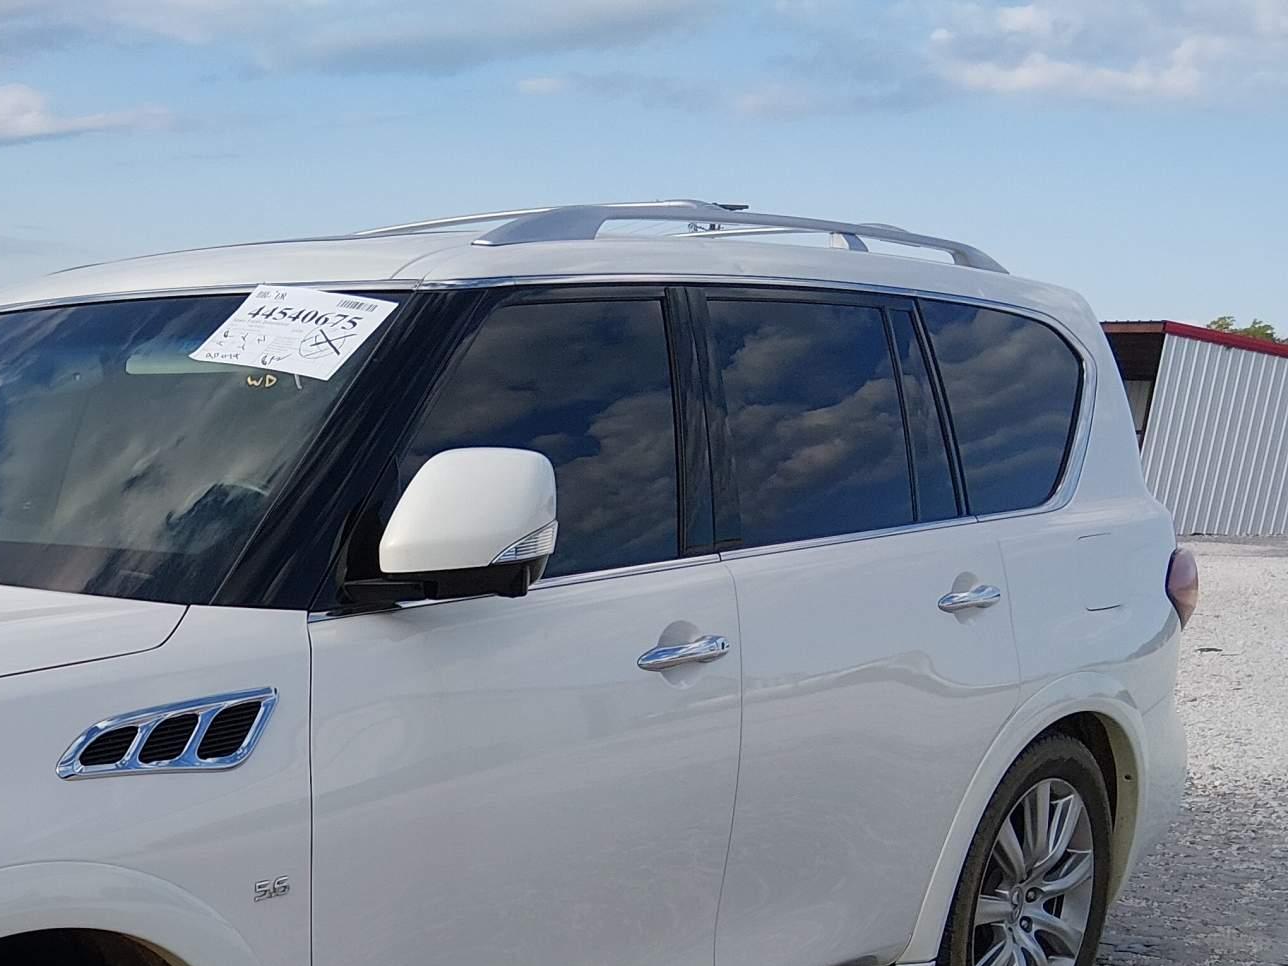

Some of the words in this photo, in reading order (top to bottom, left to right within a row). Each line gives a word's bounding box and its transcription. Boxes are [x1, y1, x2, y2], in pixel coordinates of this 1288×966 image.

[247, 305, 363, 330] 44540675
[246, 374, 278, 389] WD
[254, 874, 290, 903] 5.6
